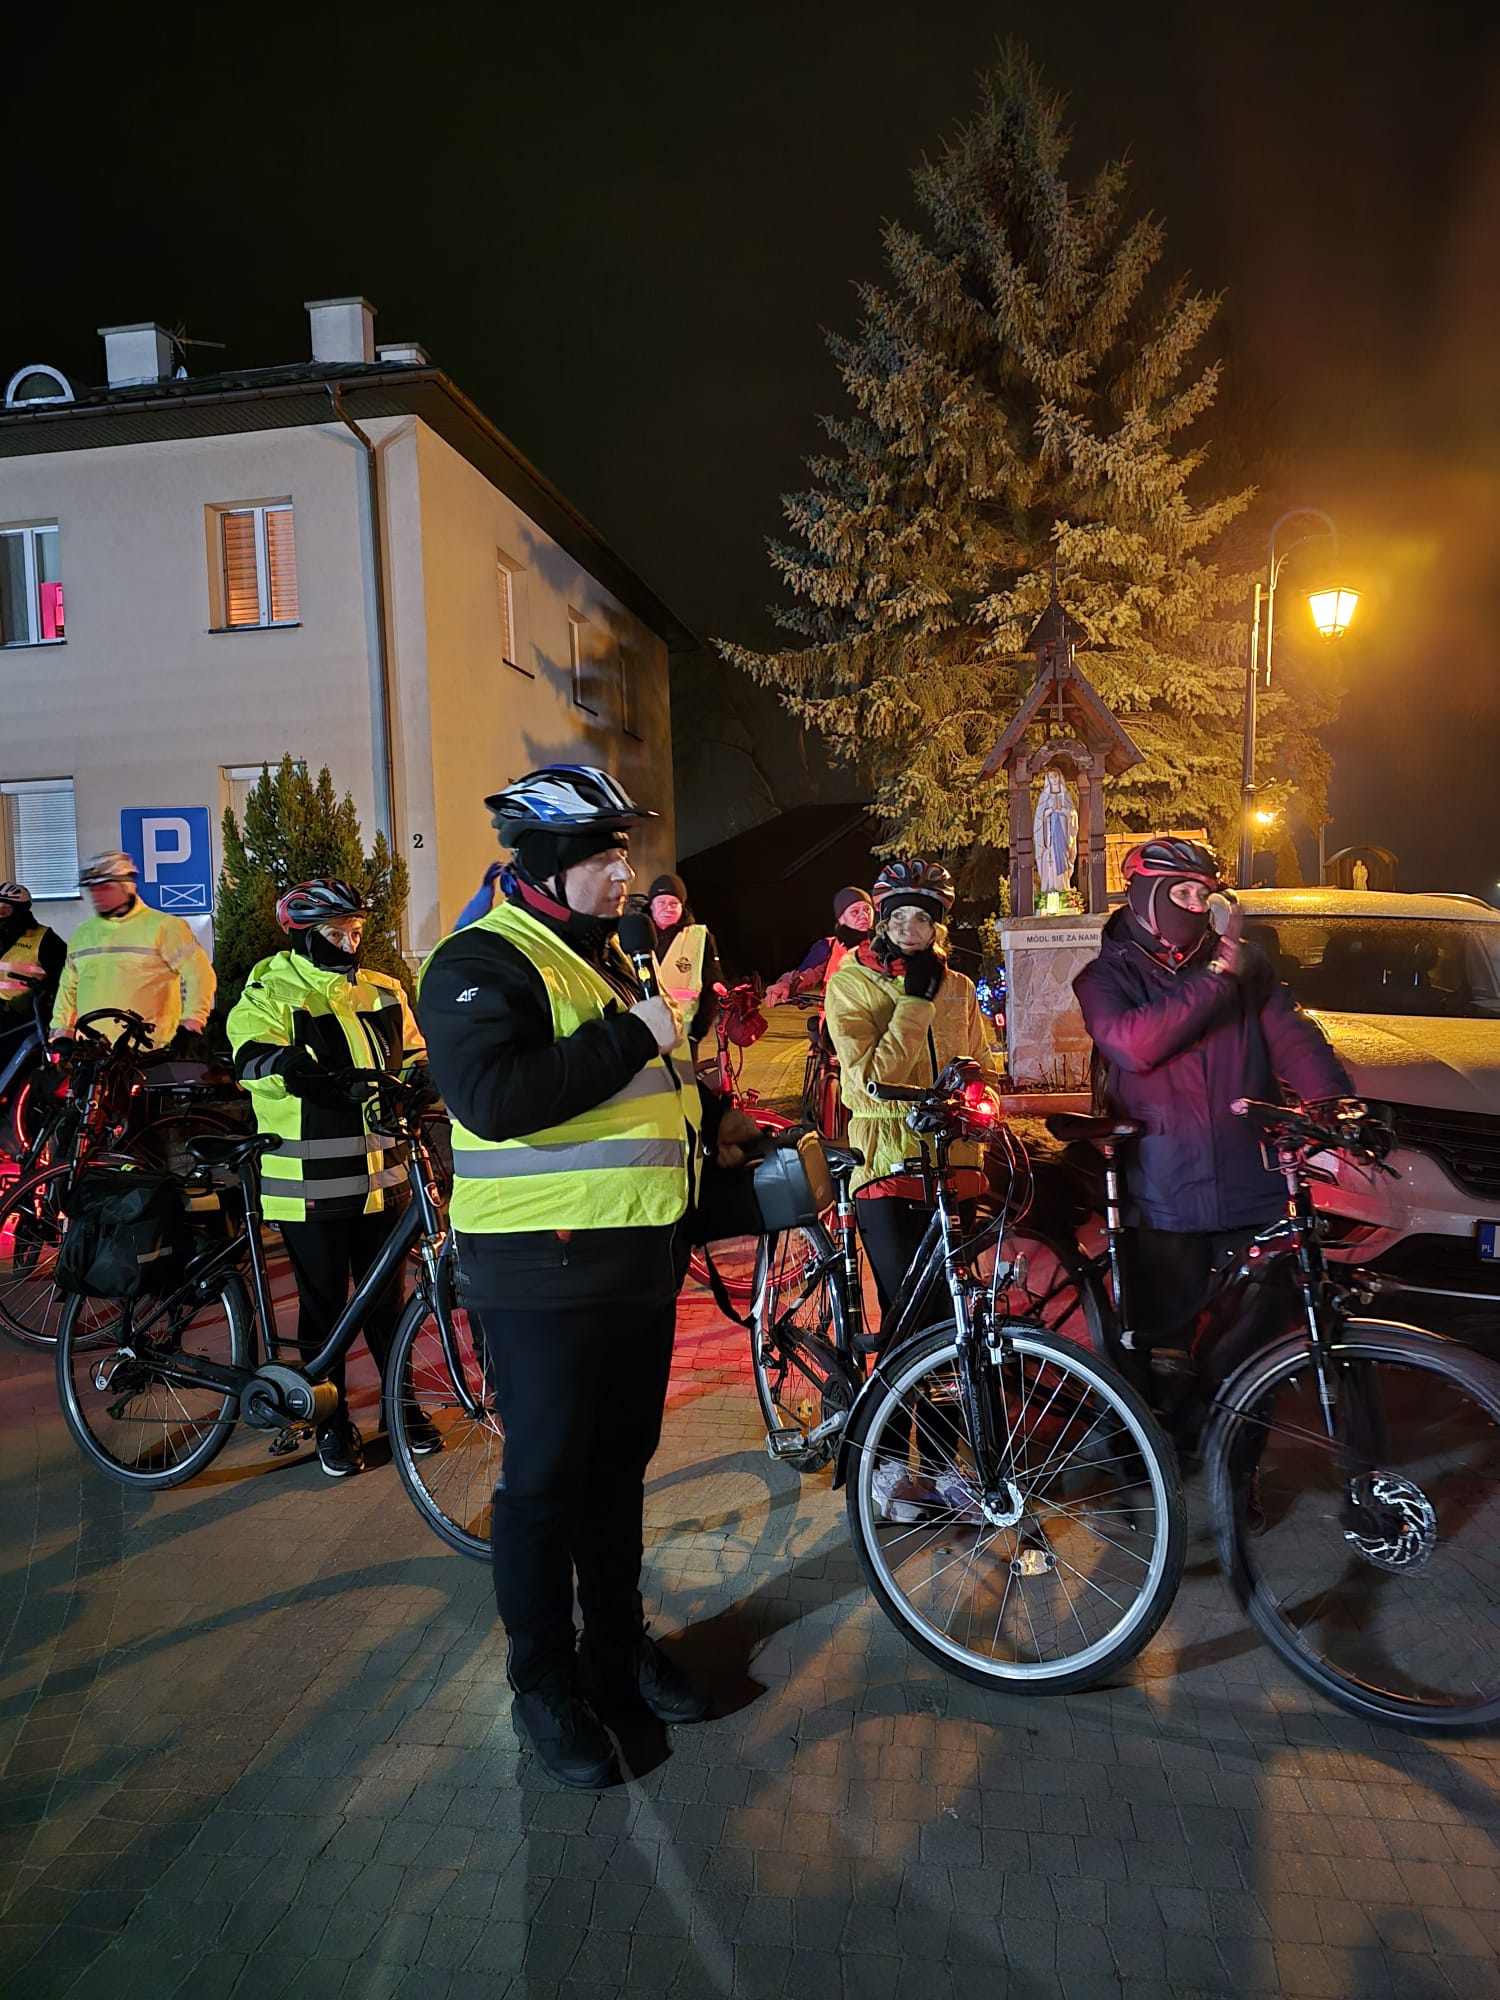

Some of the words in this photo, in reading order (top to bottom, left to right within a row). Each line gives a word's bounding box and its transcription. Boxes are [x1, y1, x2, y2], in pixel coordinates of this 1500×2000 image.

[413, 833, 424, 849] 2
[142, 817, 191, 883] P
[1026, 934, 1049, 943] MÓDL
[1051, 935, 1064, 943] SIĘ
[1066, 934, 1077, 942] ZA
[1078, 933, 1099, 941] NAMI
[455, 987, 480, 1002] 4F
[1481, 1244, 1493, 1253] PL
